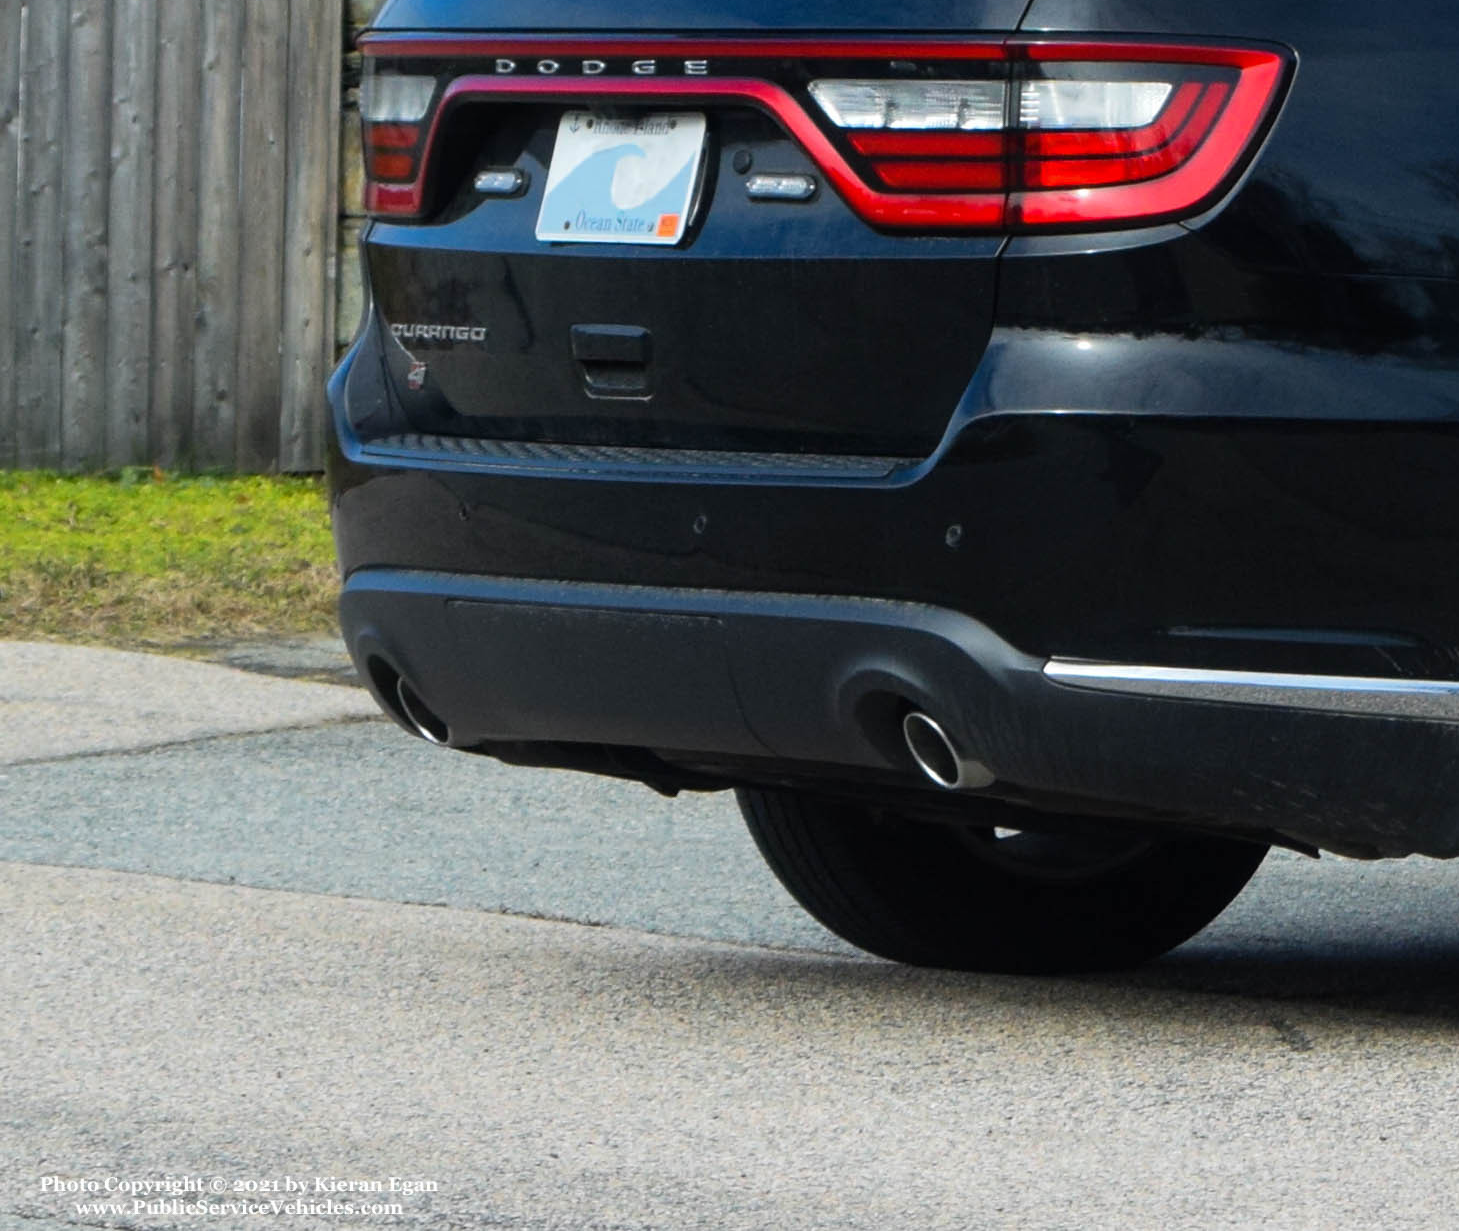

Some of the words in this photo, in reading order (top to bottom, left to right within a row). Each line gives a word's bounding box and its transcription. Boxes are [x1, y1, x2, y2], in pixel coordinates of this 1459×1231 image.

[495, 58, 708, 75] DODGE
[576, 209, 613, 232] Ocean
[614, 210, 645, 233] State
[391, 323, 487, 341] DURANGO
